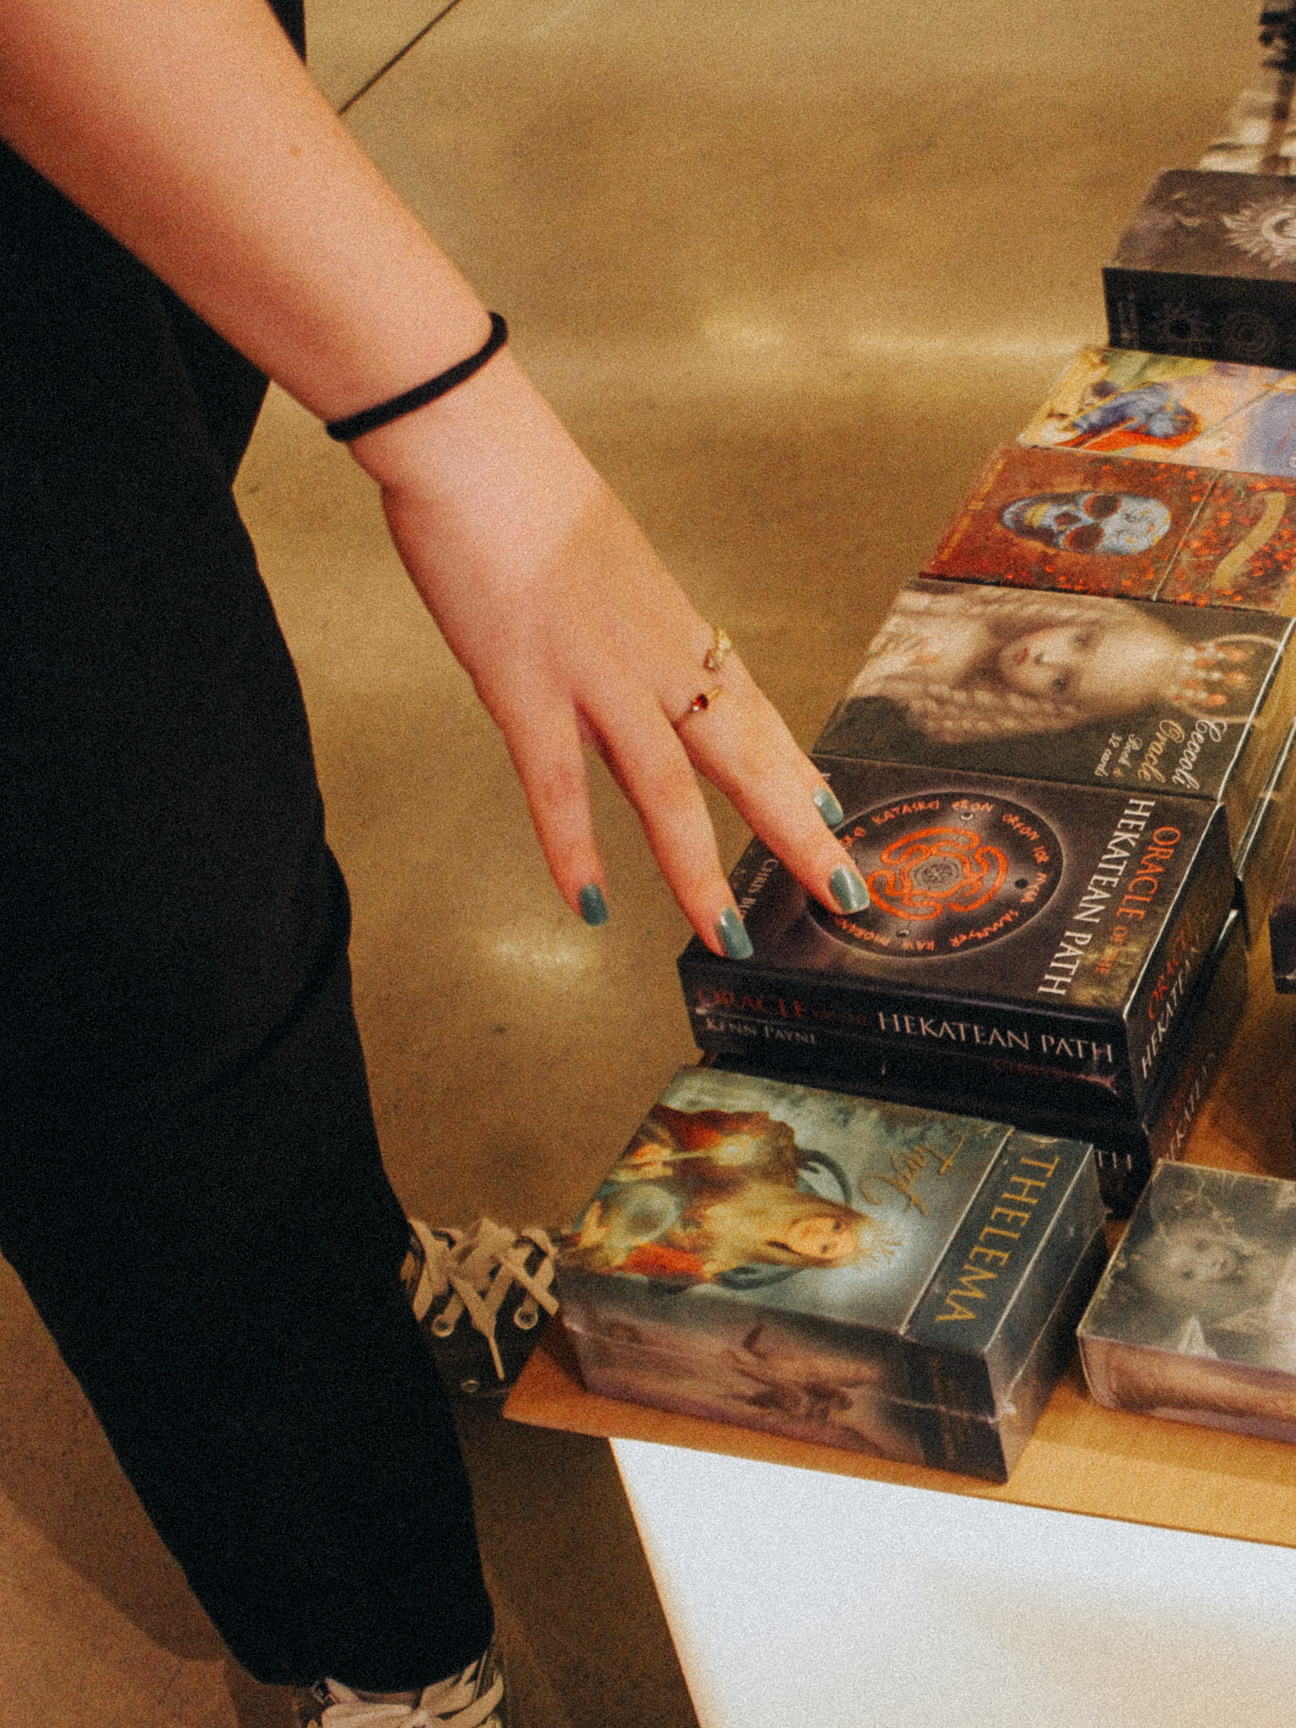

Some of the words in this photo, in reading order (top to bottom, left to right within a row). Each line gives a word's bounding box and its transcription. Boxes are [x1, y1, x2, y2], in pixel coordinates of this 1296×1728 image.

[1137, 719, 1185, 783] Oracle
[1171, 718, 1227, 790] Ceccoli
[1072, 798, 1156, 924] HEKATEAN
[1115, 826, 1181, 920] ORACLE
[1037, 931, 1093, 996] PATH
[877, 1011, 1030, 1050] HEKATEAN
[1041, 1034, 1114, 1063] PATH
[934, 1155, 1061, 1323] THELEMA
